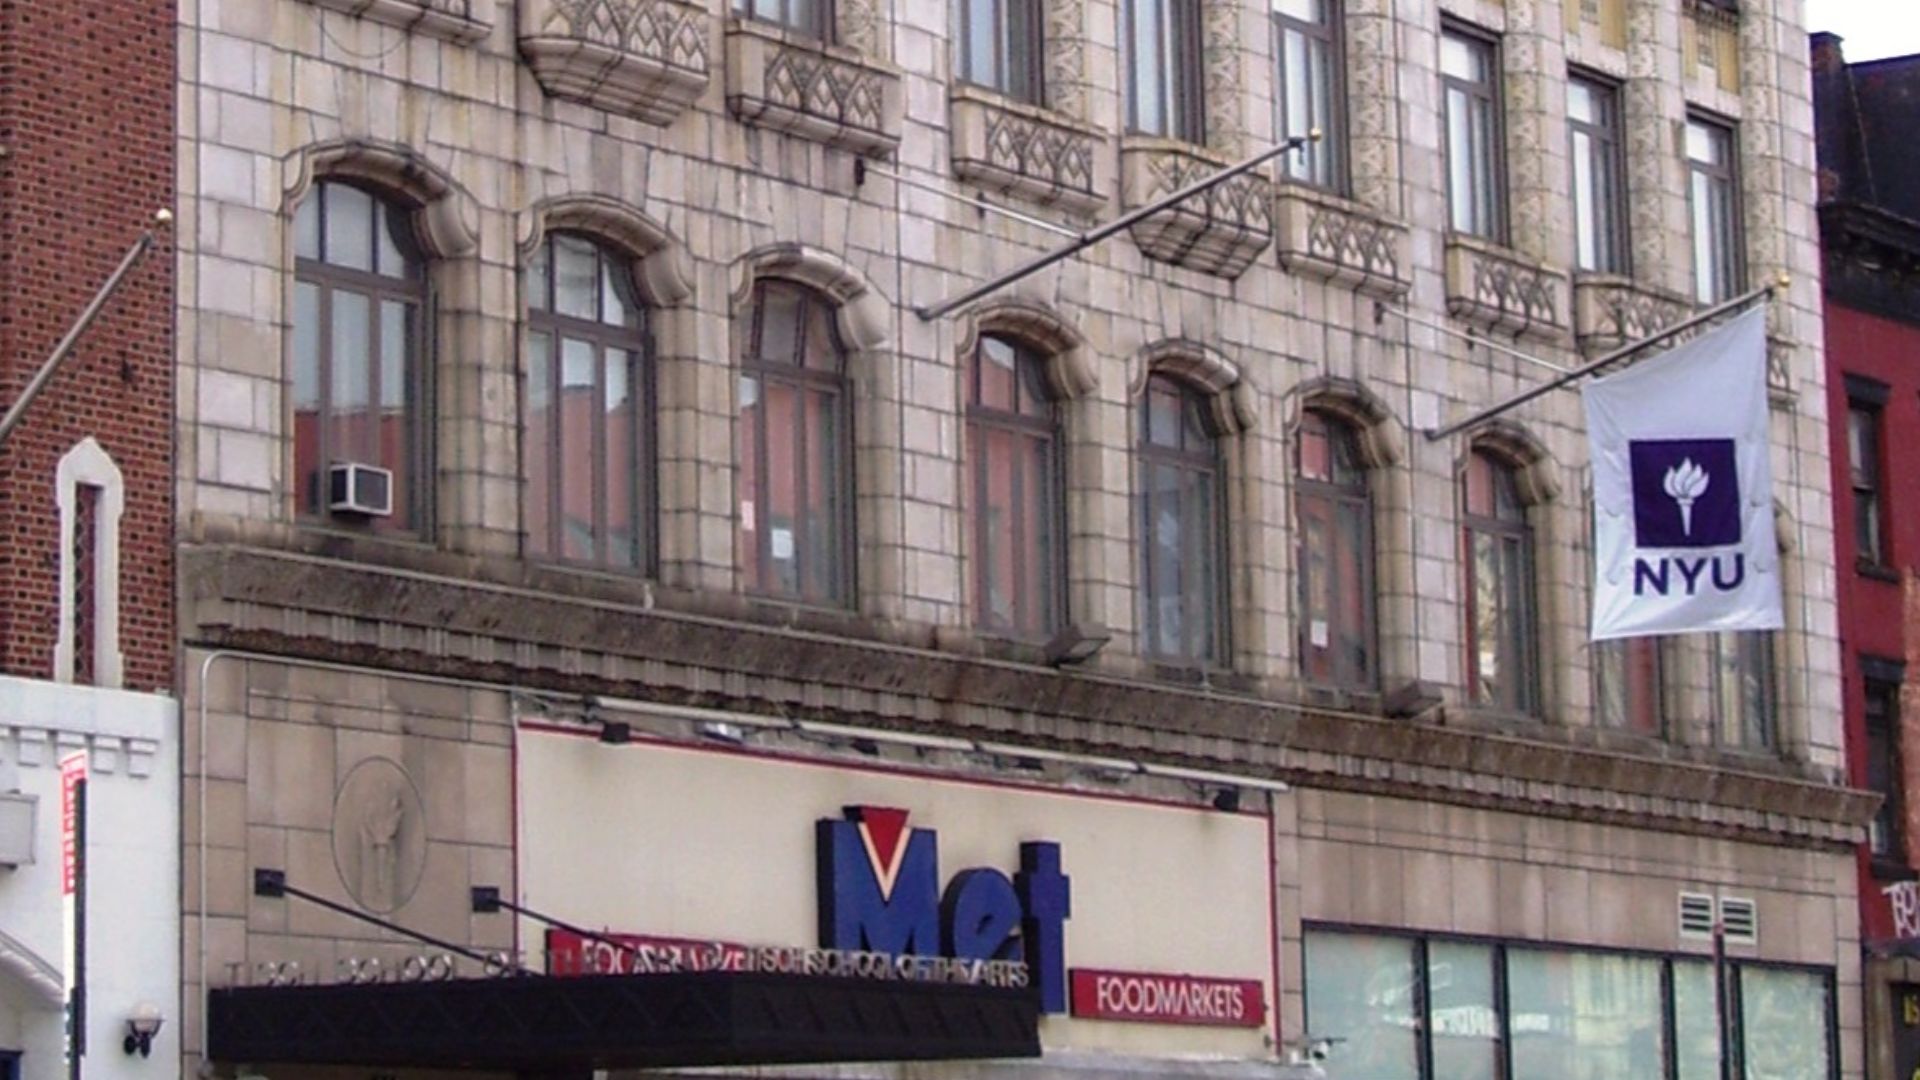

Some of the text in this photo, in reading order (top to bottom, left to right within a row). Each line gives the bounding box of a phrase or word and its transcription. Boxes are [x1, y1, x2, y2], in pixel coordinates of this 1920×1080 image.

[1634, 553, 1745, 596] NYU
[816, 805, 1071, 1014] Met
[1096, 976, 1245, 1019] FOODMARKETS
